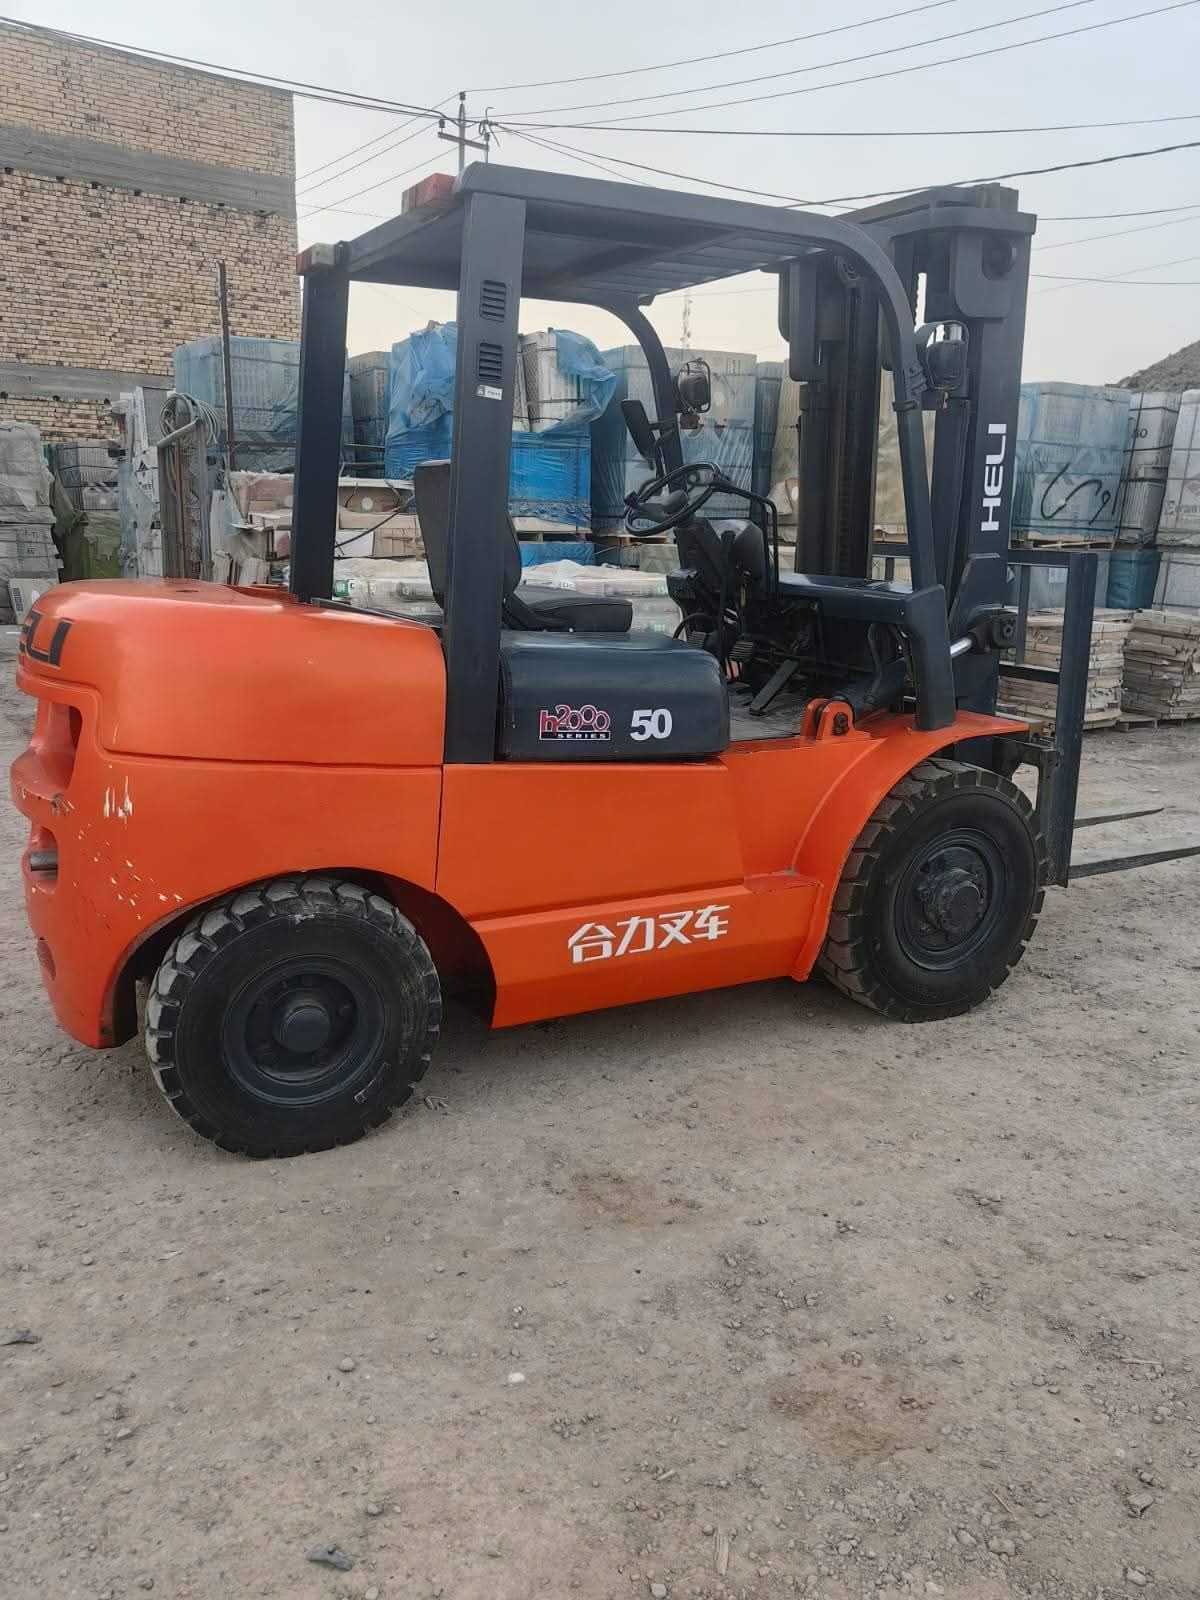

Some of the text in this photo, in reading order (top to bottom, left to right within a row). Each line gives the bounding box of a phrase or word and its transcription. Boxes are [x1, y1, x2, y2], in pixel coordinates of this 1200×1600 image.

[981, 423, 1007, 531] HELI
[630, 708, 673, 741] 50
[568, 904, 732, 964] 合力叉车
